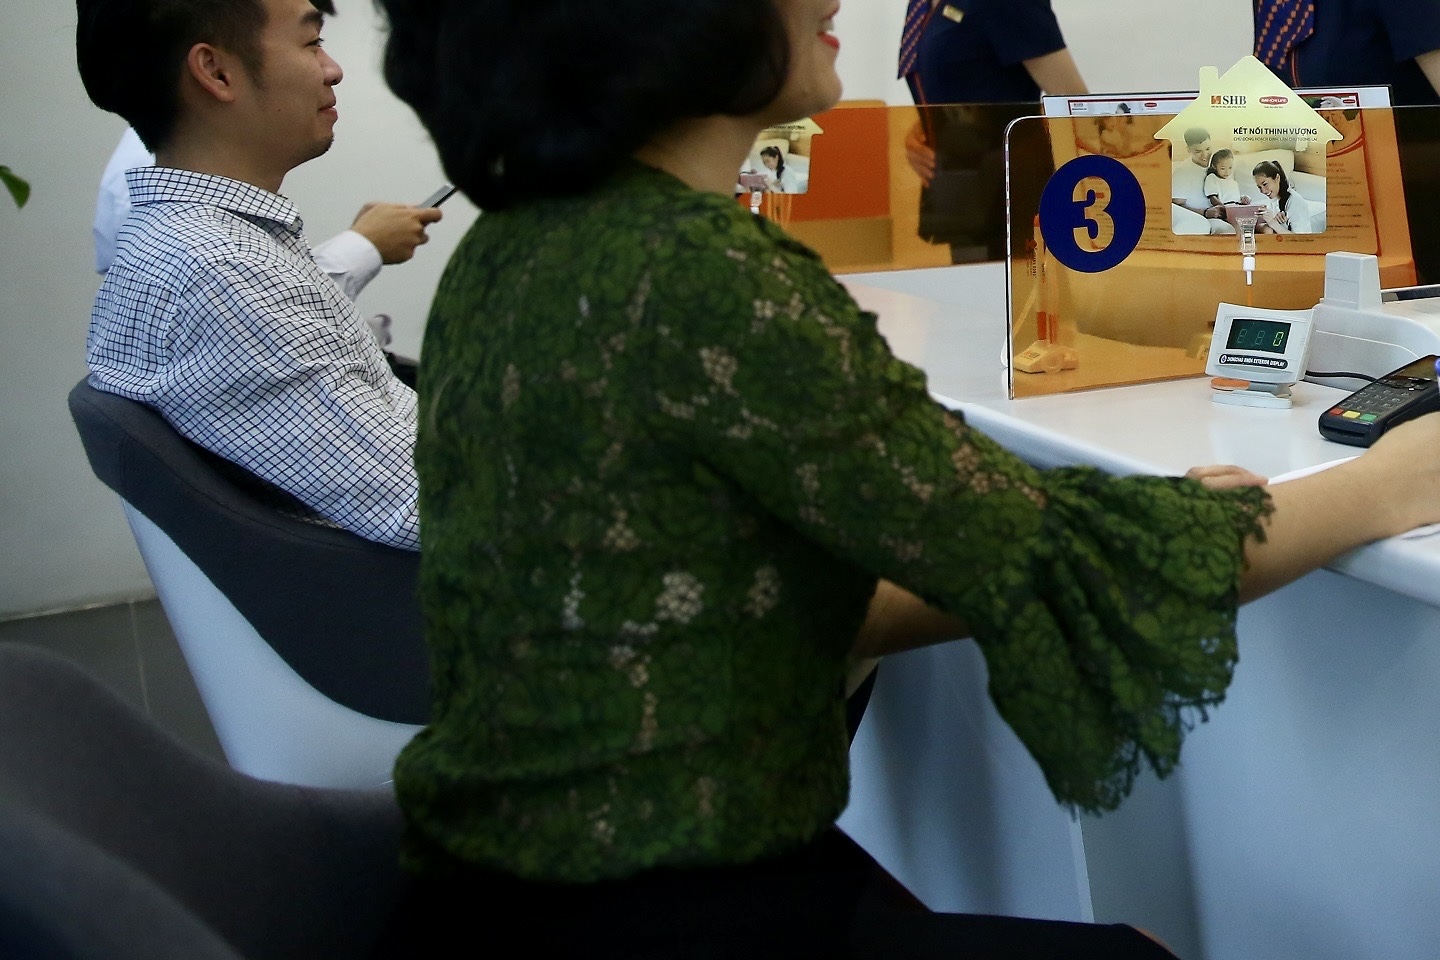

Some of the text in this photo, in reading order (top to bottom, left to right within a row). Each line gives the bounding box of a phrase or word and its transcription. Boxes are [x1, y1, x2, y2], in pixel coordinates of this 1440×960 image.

[1222, 95, 1247, 106] SHB
[1233, 125, 1318, 137] KẾT NỐI THỊNH VƯỢNG
[1072, 175, 1115, 252] 3
[1272, 331, 1284, 347] 0
